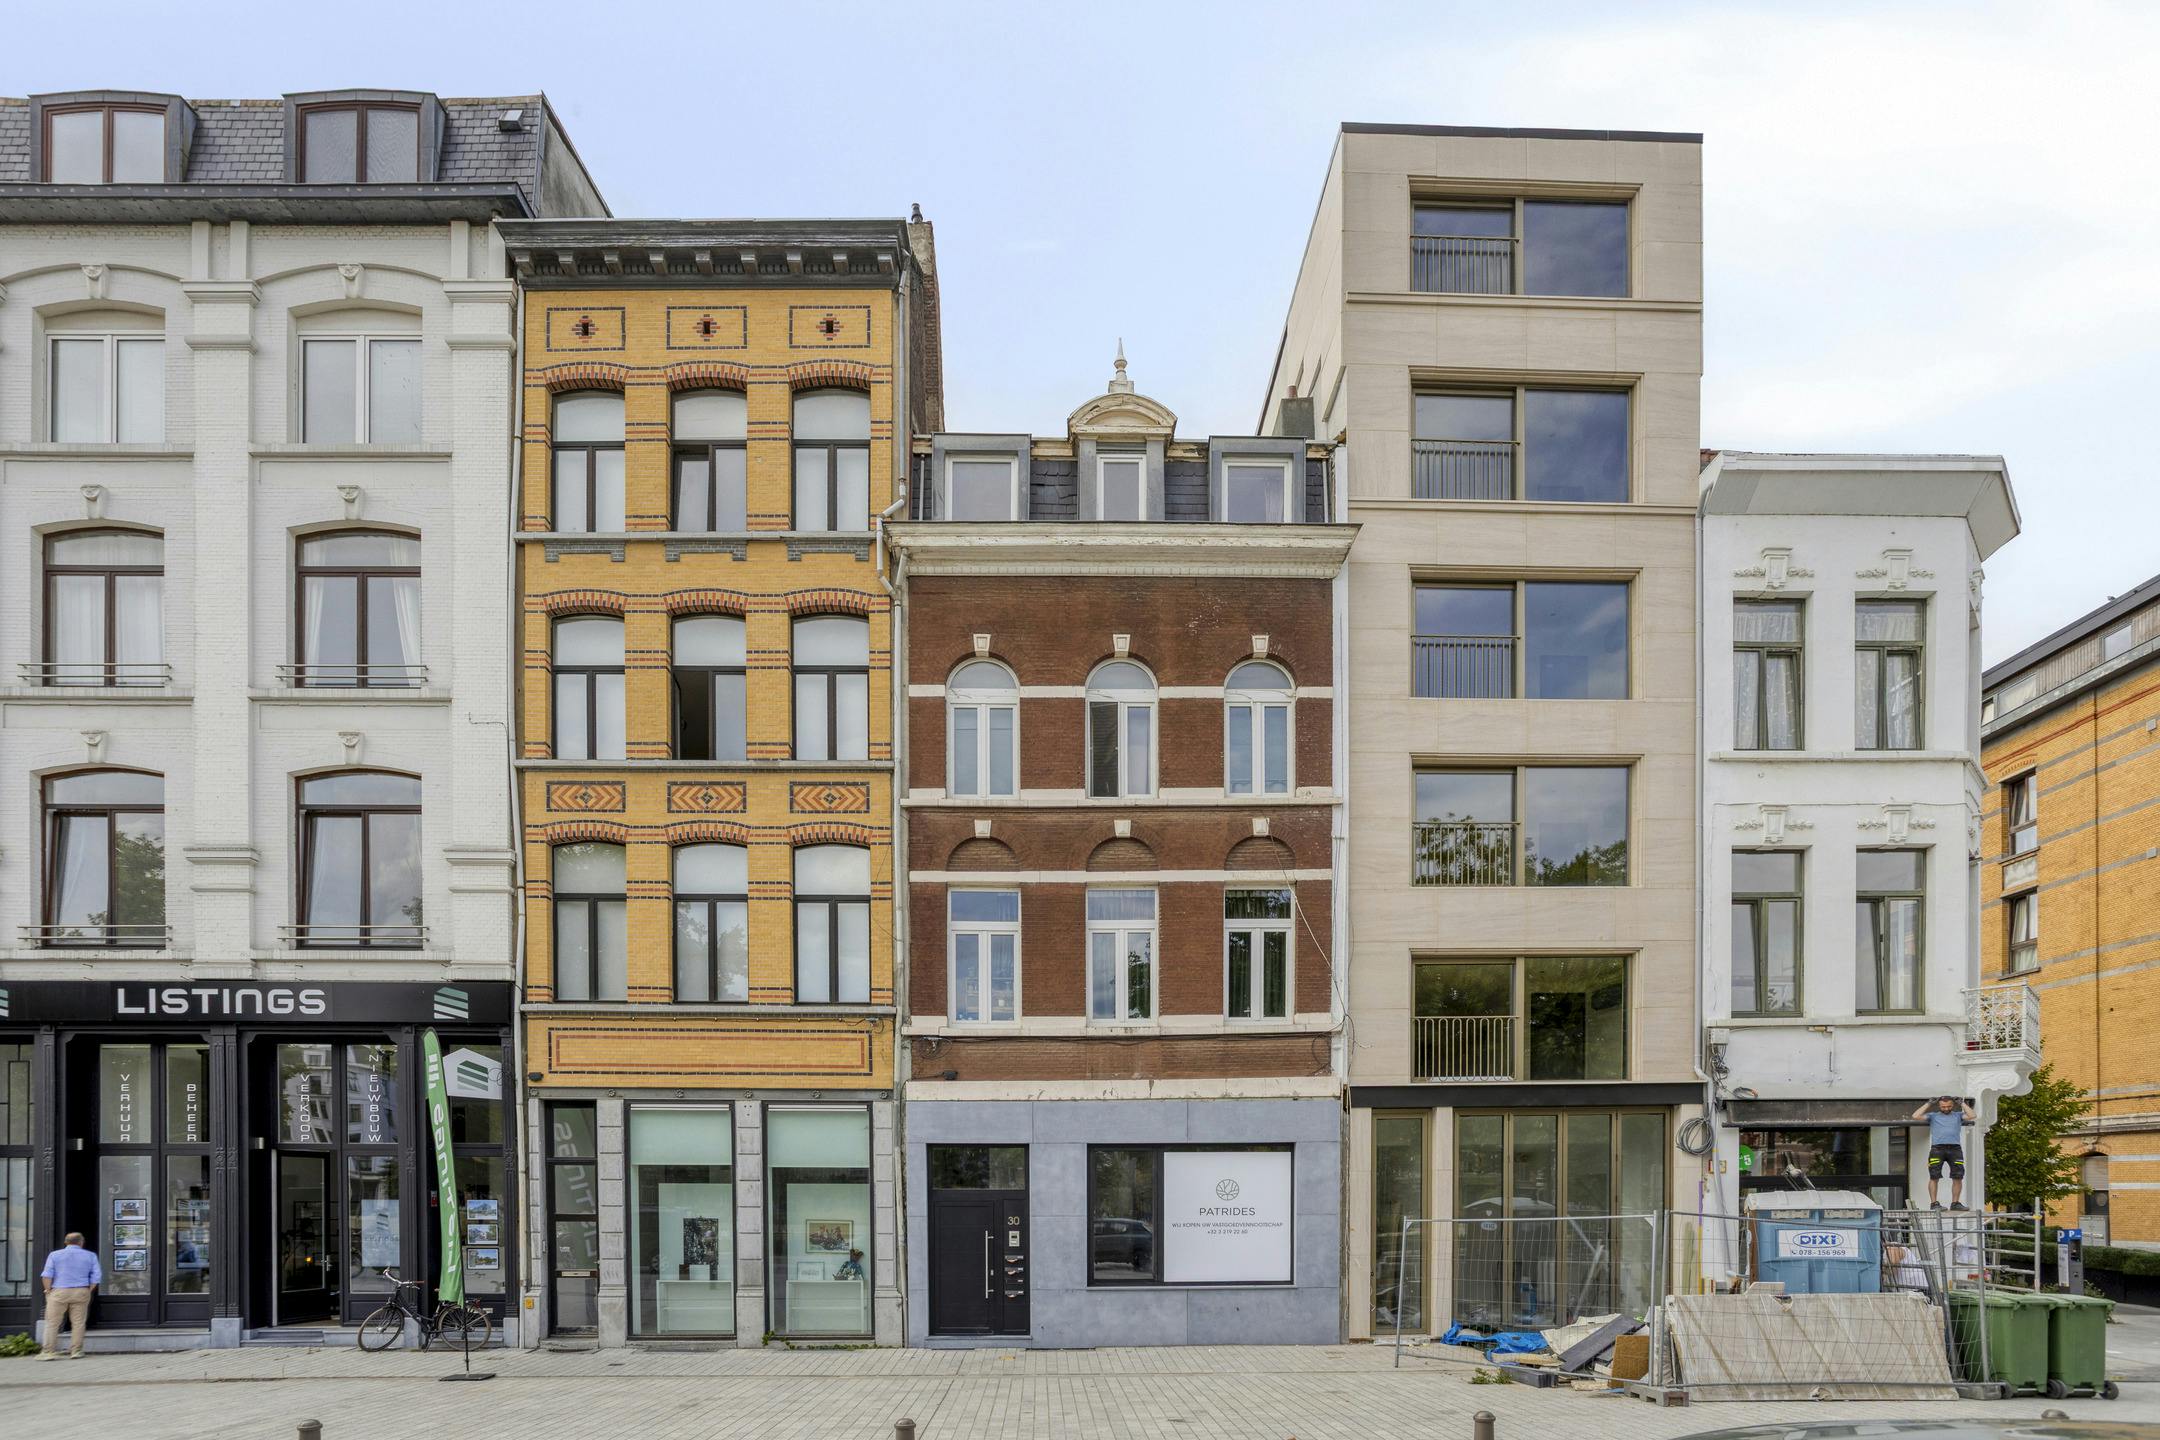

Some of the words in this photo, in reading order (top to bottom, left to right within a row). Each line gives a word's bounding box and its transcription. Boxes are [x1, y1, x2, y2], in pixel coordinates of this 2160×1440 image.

[117, 988, 326, 1014] LISTINGS
[120, 1074, 130, 1142] VERHUUR
[186, 1083, 197, 1142] BEHEER
[300, 1074, 311, 1142] VERKOOP
[368, 1054, 381, 1142] NIEUWBOUW
[1007, 1216, 1020, 1226] 30
[1199, 1207, 1256, 1216] PATRIDES
[2058, 1230, 2065, 1242] P
